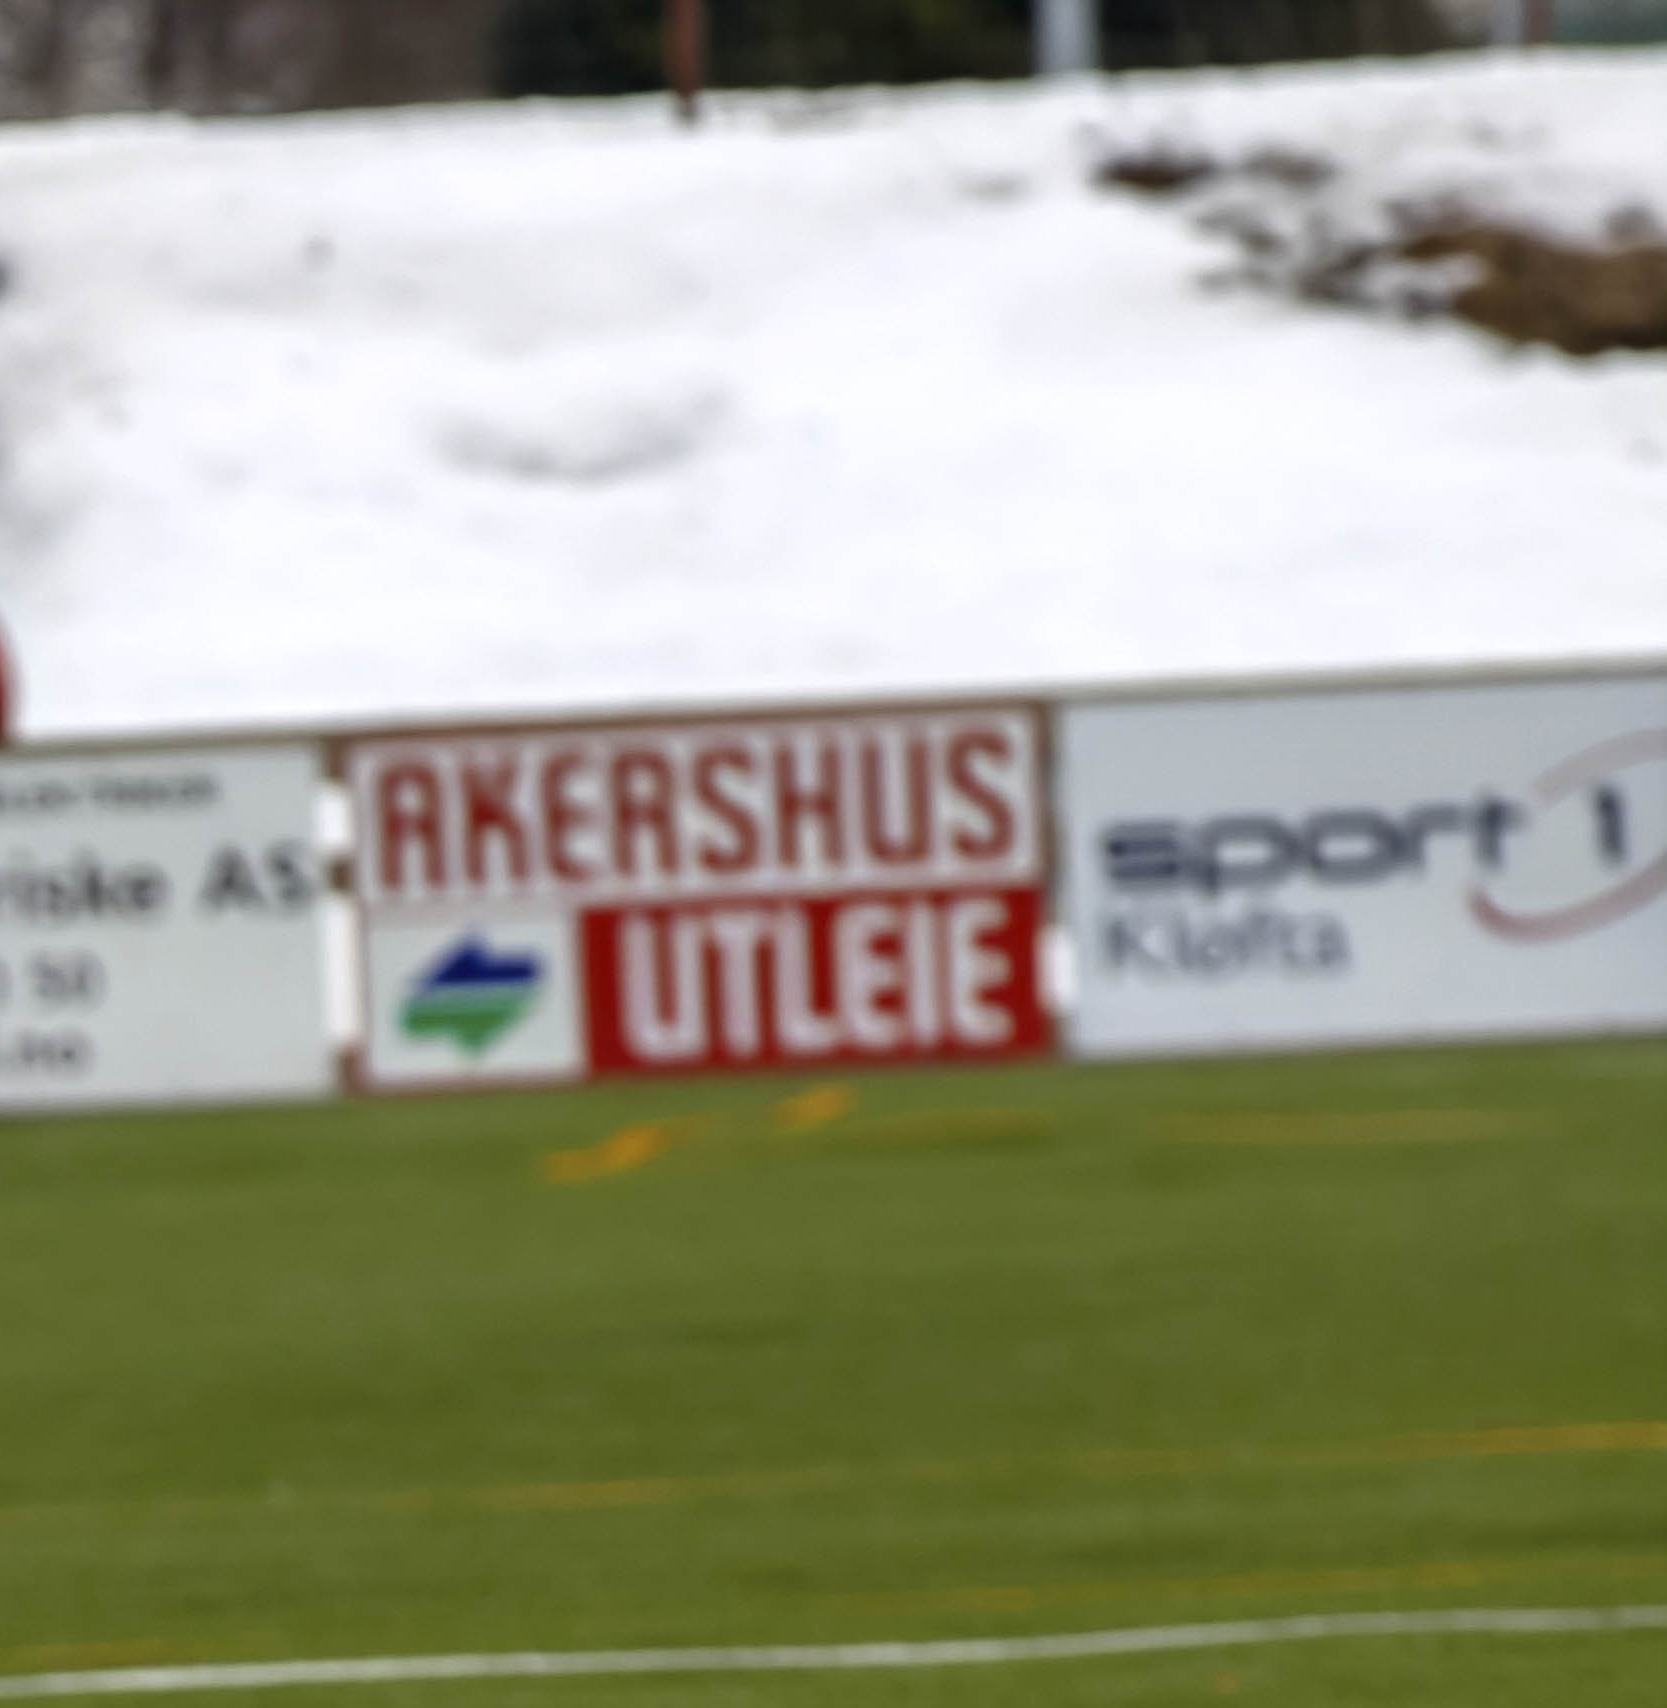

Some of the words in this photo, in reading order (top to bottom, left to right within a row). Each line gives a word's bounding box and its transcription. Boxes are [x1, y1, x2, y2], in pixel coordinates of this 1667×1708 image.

[373, 724, 1015, 892] AKERSHUS
[1100, 783, 1529, 895] sport
[200, 842, 315, 914] AS
[615, 895, 1011, 1062] UTLEIE
